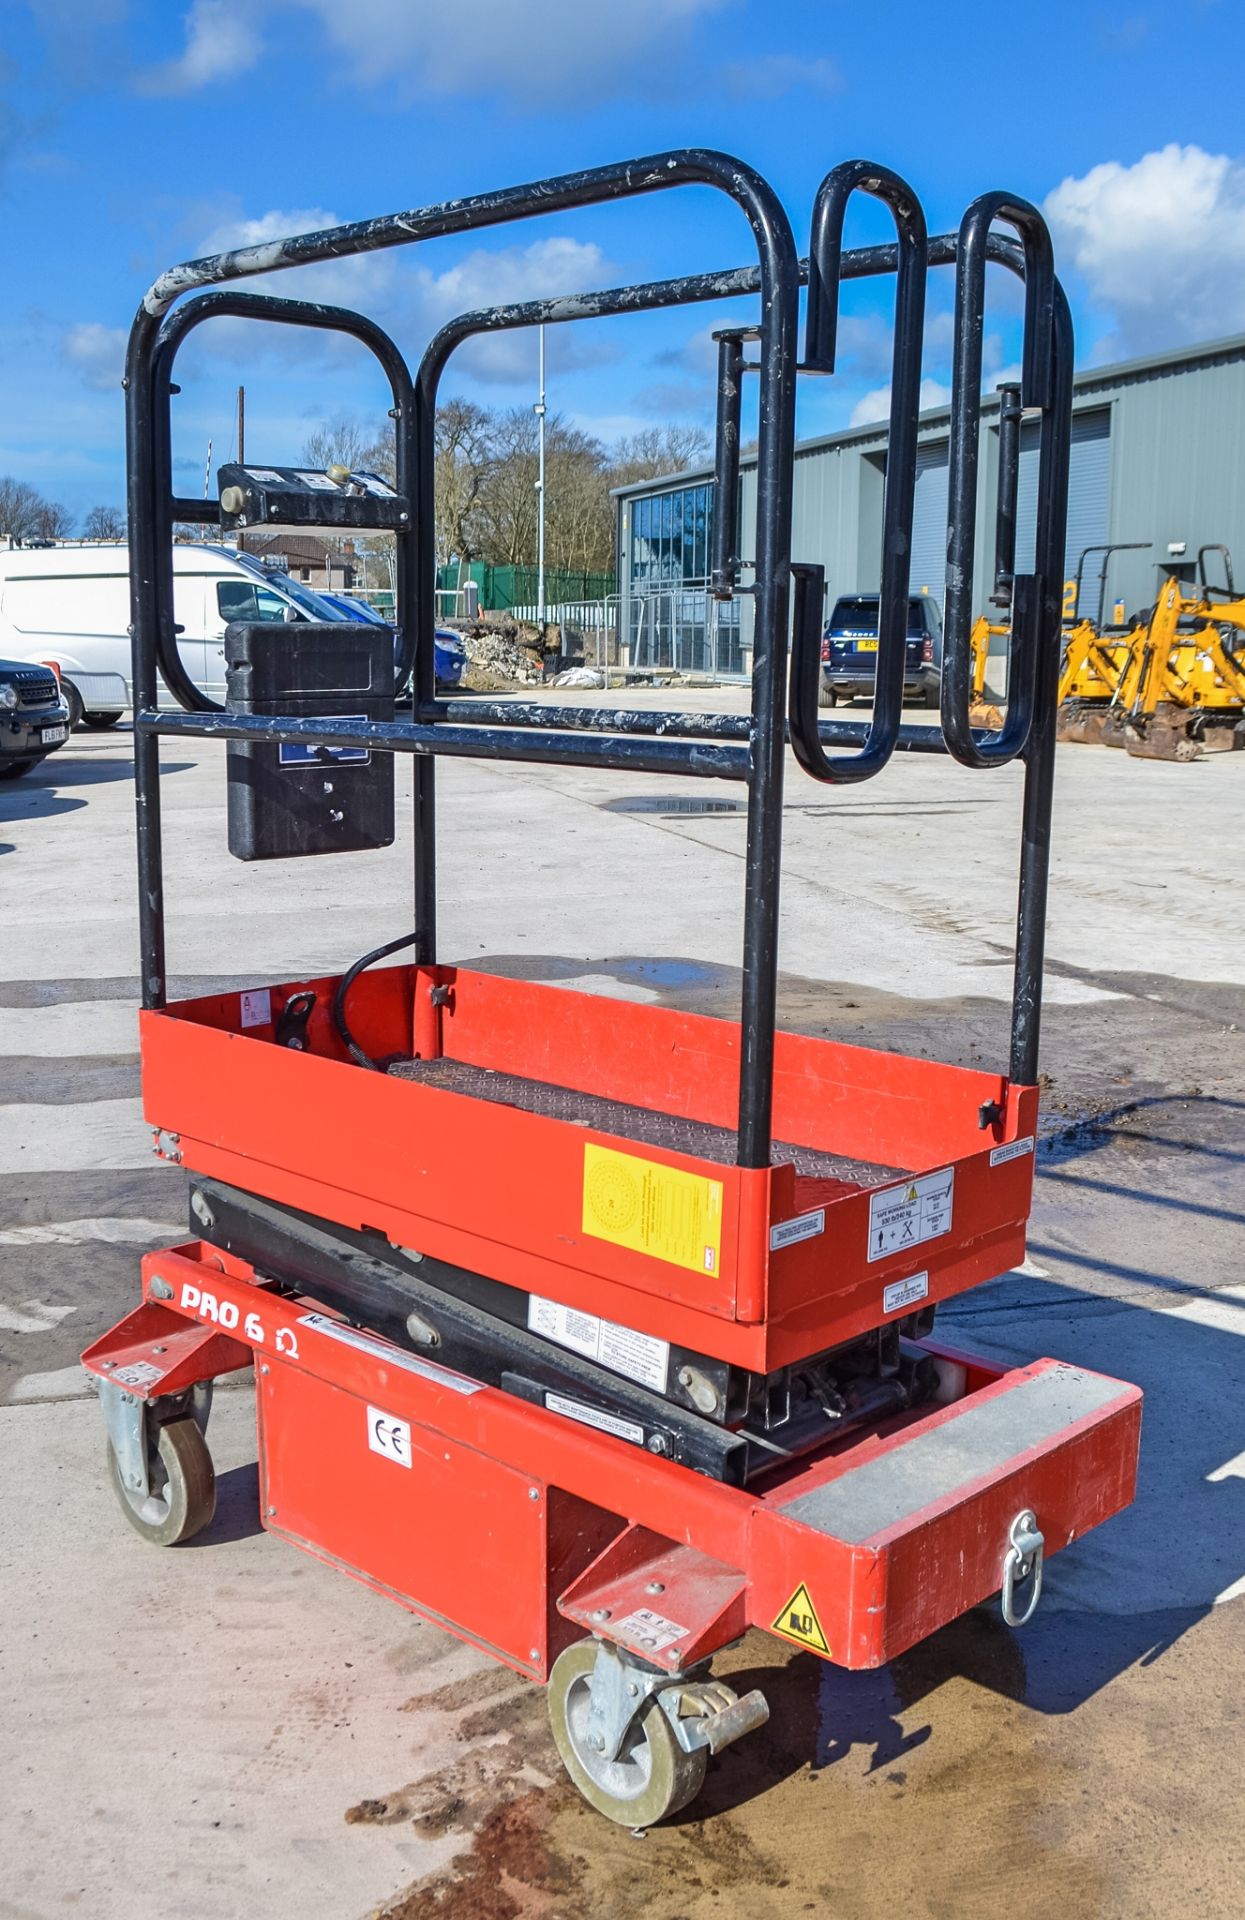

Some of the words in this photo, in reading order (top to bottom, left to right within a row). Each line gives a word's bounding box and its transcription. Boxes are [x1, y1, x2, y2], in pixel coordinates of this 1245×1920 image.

[180, 1283, 240, 1329] PRO
[244, 1312, 265, 1343] 6
[375, 1419, 403, 1455] CE
